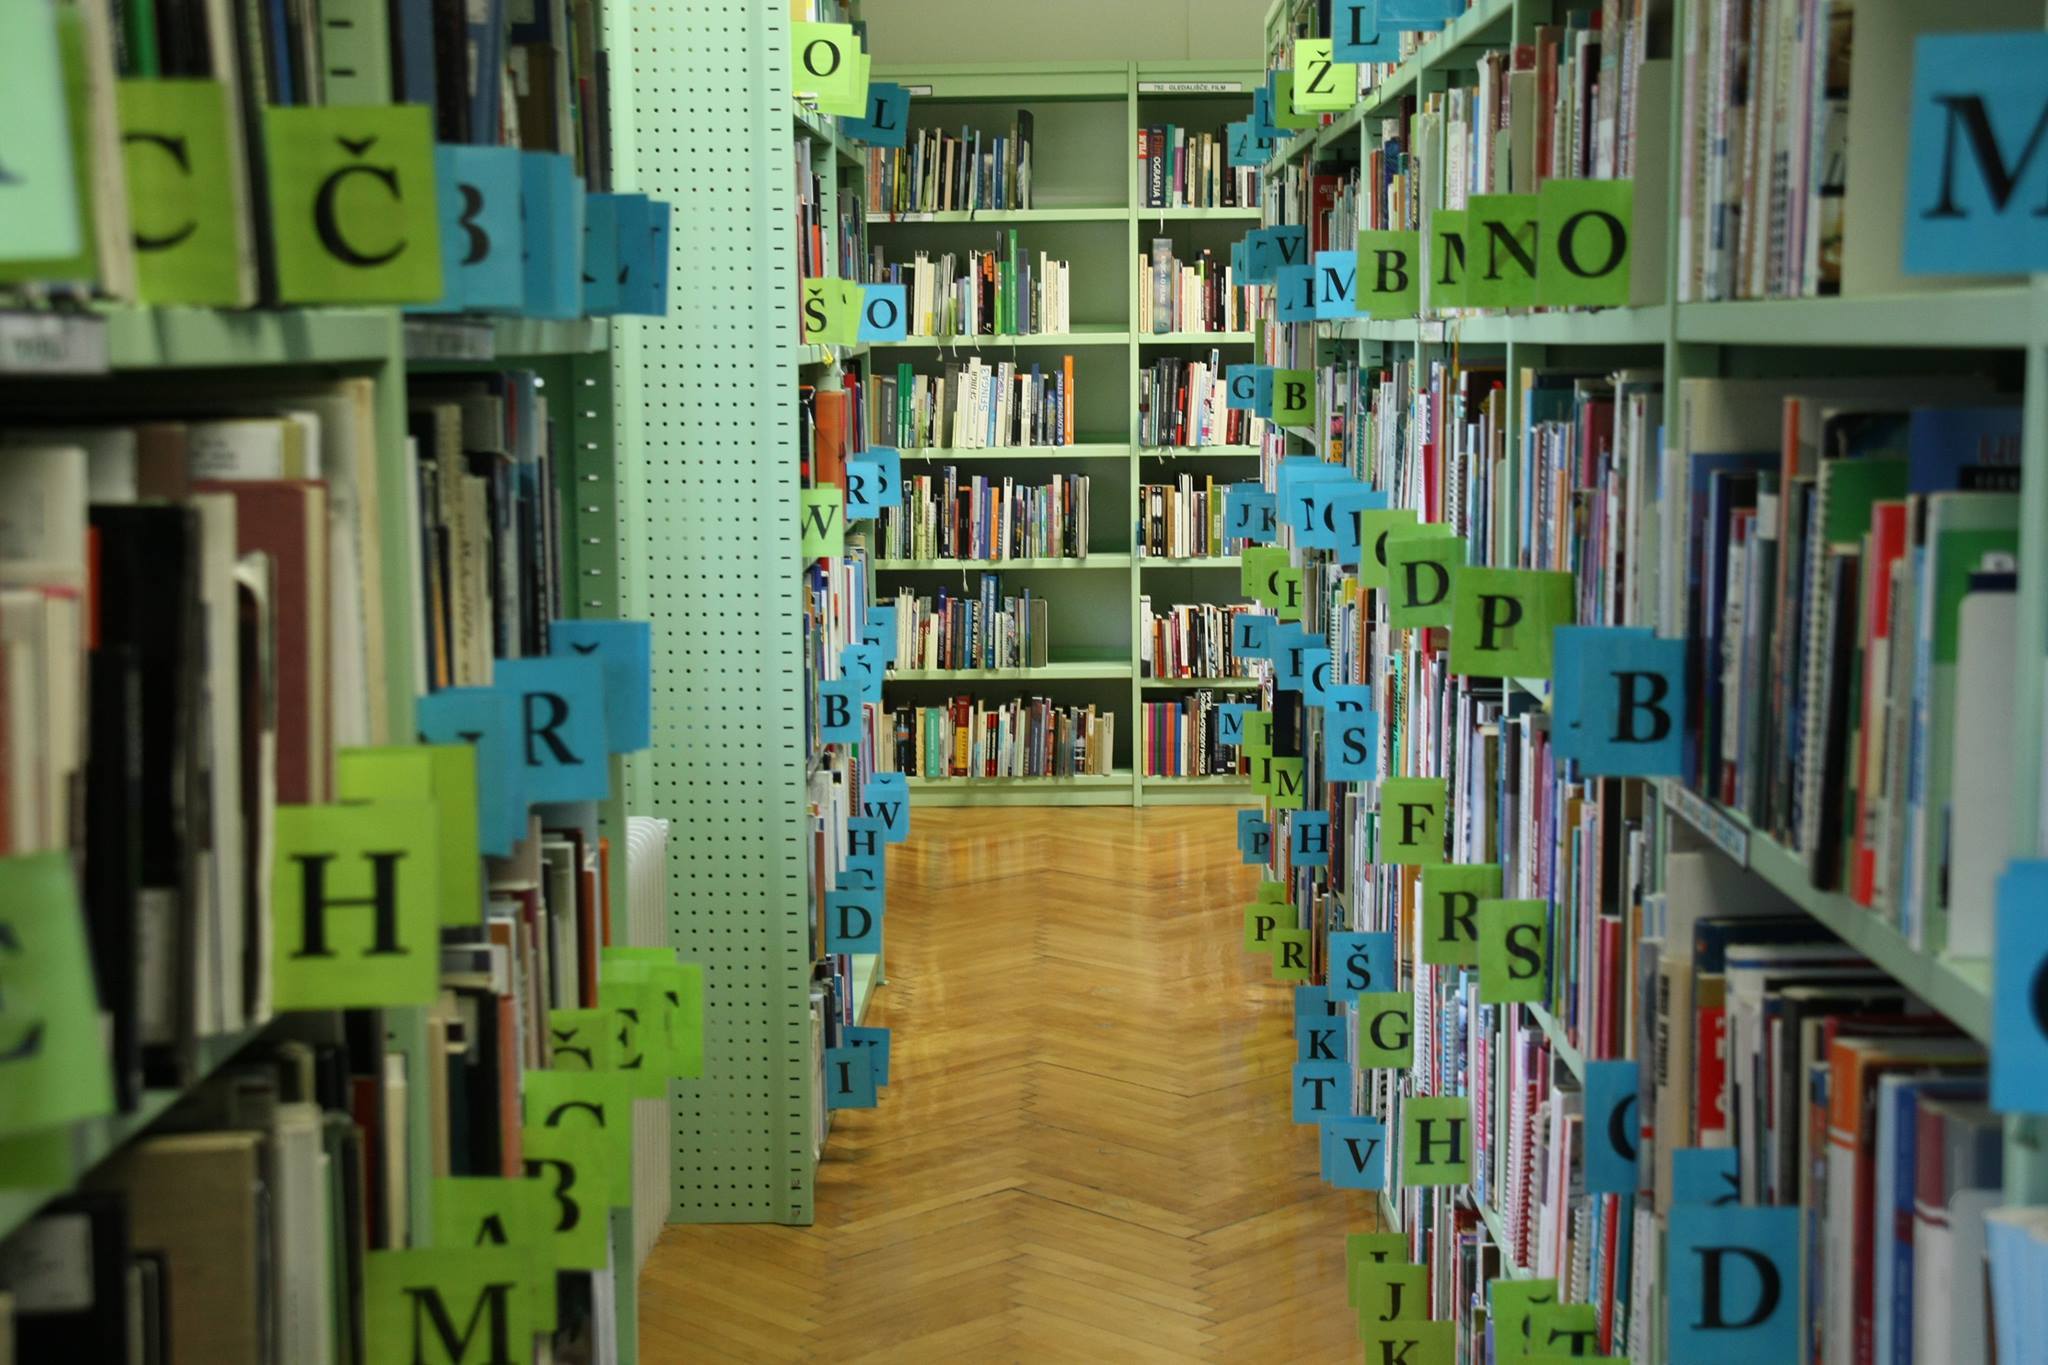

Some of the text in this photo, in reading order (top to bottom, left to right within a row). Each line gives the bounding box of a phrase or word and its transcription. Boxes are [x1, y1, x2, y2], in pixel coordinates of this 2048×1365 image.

[1347, 6, 1380, 46] L
[803, 39, 841, 77] O
[1305, 50, 1336, 94] Ž
[871, 97, 896, 130] L
[312, 135, 408, 269] Č
[1276, 236, 1303, 265] V
[1557, 210, 1627, 278] O
[1372, 250, 1408, 293] B
[804, 288, 827, 333] Š
[866, 298, 898, 329] O
[1232, 375, 1255, 399] G
[1283, 382, 1307, 411] B
[846, 474, 869, 505] R
[801, 504, 839, 540] W
[1236, 503, 1252, 527] J
[1400, 559, 1449, 609] D
[1241, 625, 1262, 649] L
[1474, 593, 1523, 651] P
[822, 694, 851, 728] B
[1608, 671, 1671, 744] B
[523, 692, 584, 767] R
[1343, 727, 1367, 765] S
[1298, 824, 1329, 854] H
[1398, 802, 1435, 845] F
[847, 830, 876, 856] H
[1252, 832, 1269, 854] P
[288, 850, 409, 959] H
[836, 905, 872, 940] D
[1437, 891, 1478, 942] R
[1254, 916, 1276, 942] P
[1281, 942, 1307, 969] R
[1346, 944, 1371, 990] Š
[1505, 924, 1542, 980] S
[1308, 1029, 1338, 1060] K
[1370, 1010, 1413, 1051] G
[1302, 1077, 1335, 1111] T
[1343, 1138, 1381, 1174] V
[1415, 1118, 1467, 1166] H
[1379, 1282, 1406, 1322] J
[1690, 1245, 1782, 1331] D
[402, 1282, 519, 1365] M
